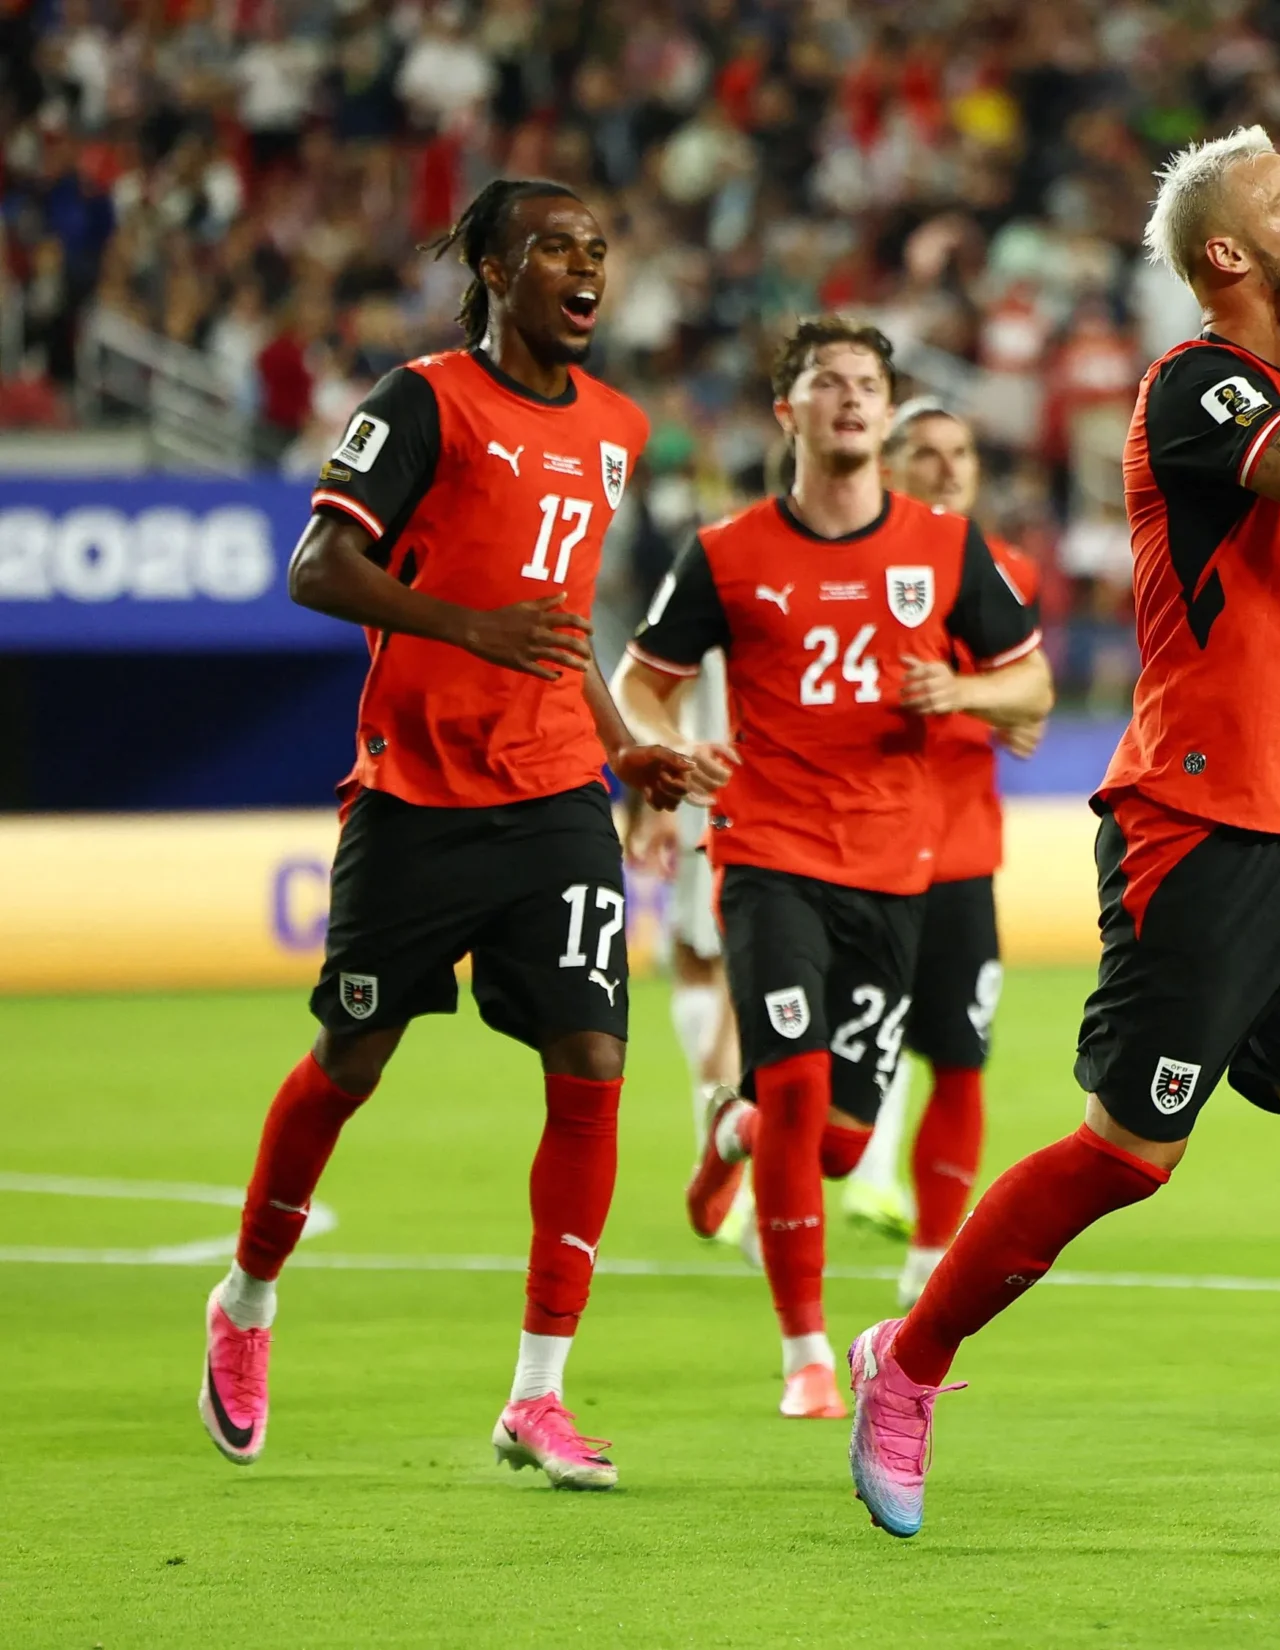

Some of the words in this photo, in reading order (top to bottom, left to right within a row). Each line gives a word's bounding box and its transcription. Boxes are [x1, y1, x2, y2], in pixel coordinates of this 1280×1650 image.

[0, 504, 272, 602] 2026
[521, 493, 594, 584] 17
[800, 622, 882, 706] 24
[559, 884, 625, 970] 17
[830, 984, 912, 1072] 24
[1170, 1063, 1189, 1073] ÖFB
